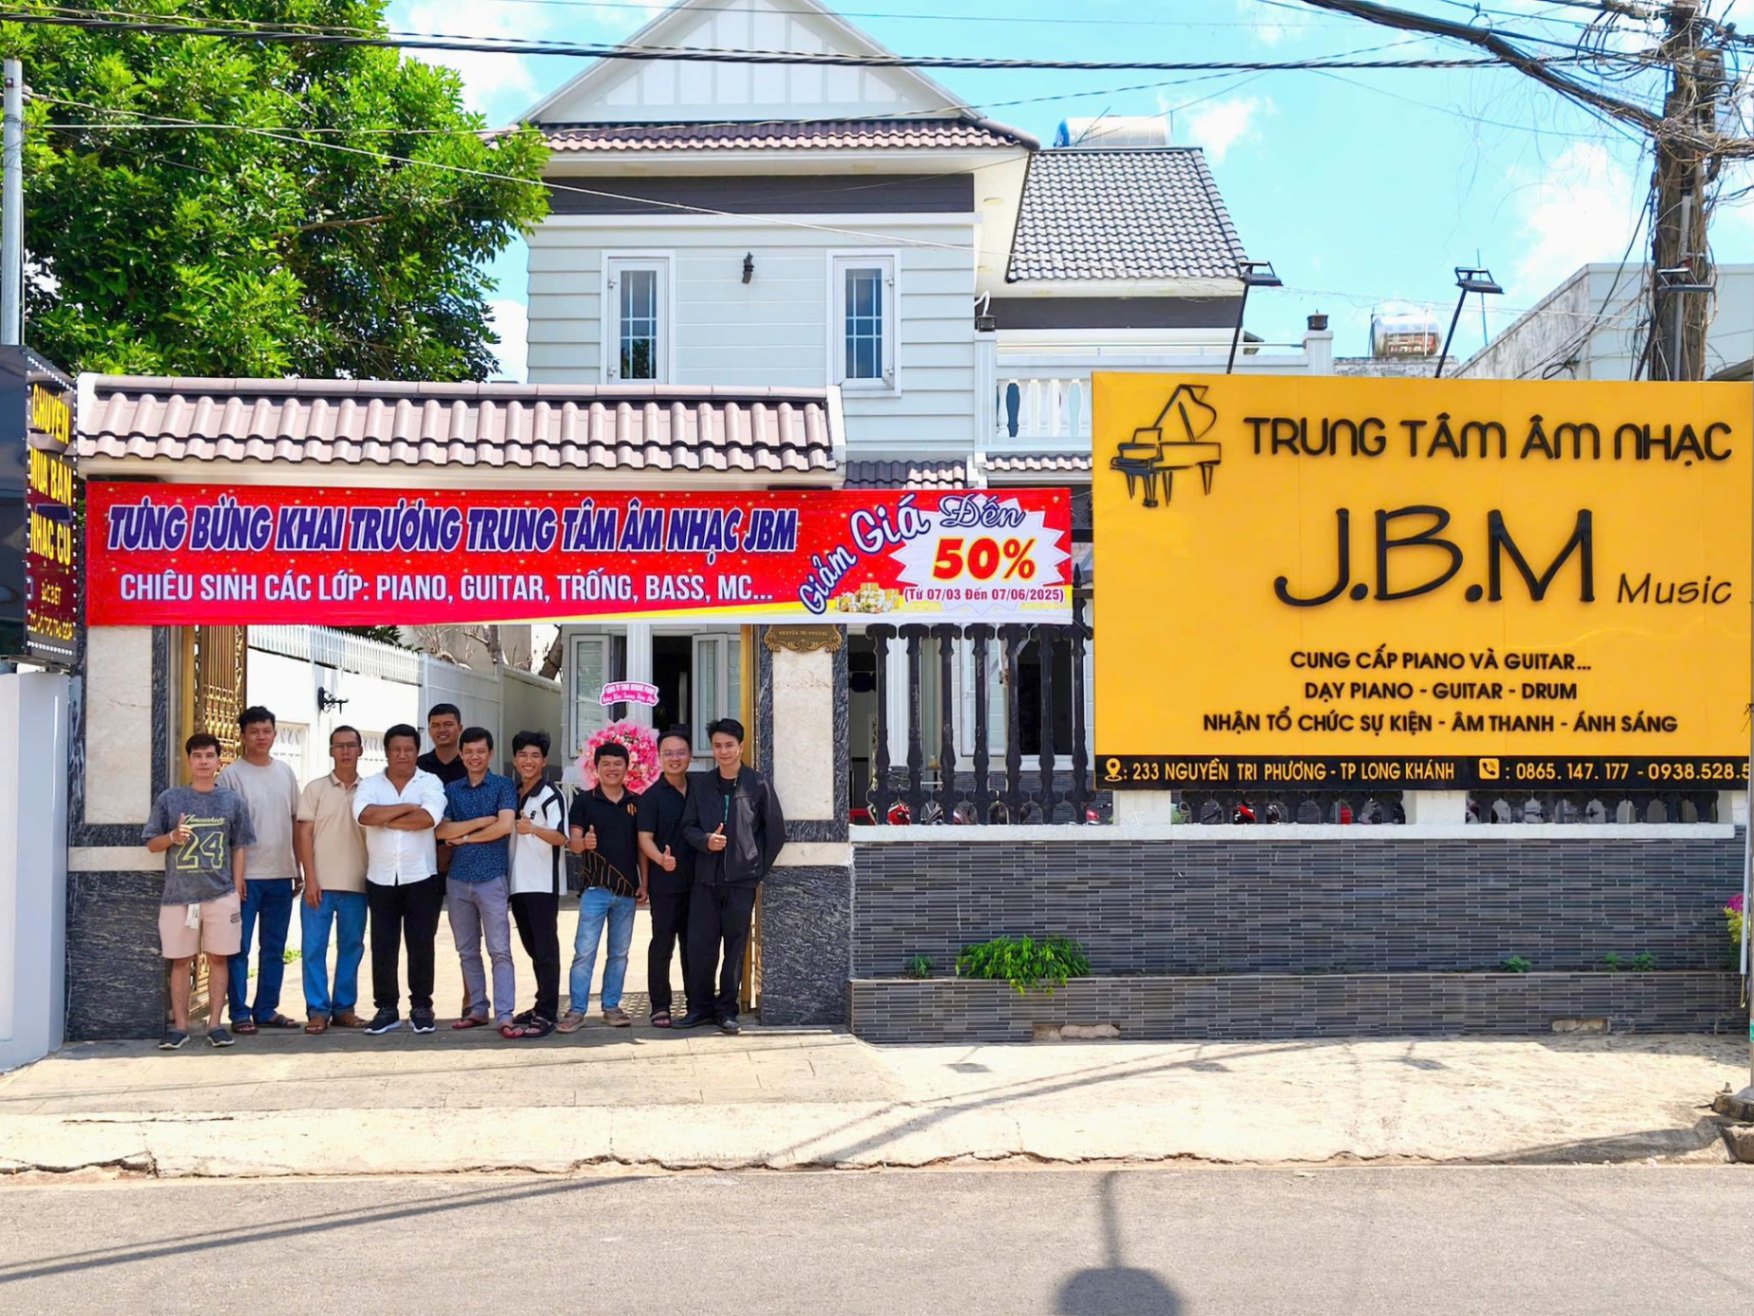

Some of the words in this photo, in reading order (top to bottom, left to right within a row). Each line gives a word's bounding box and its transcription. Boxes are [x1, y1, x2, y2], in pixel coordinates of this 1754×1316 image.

[1243, 416, 1386, 457] TRUNG
[1400, 412, 1507, 460] TÂM
[1519, 414, 1601, 461] ÂM
[1614, 421, 1734, 467] NHẠC
[30, 445, 48, 497] MUA
[50, 454, 72, 507] BÁN
[30, 511, 54, 567] NHẠC
[56, 522, 72, 575] CỤ
[189, 493, 273, 552] BỪNG
[275, 506, 346, 552] KHAI
[349, 497, 463, 553] TRƯƠNG
[466, 506, 559, 553] TRUNG
[561, 496, 619, 553] TÂM
[617, 496, 666, 552] ÂM
[665, 507, 743, 566] NHẠC
[742, 508, 799, 553] JBM
[799, 544, 859, 615] Giảm
[849, 492, 931, 555] Giá
[938, 493, 1026, 528] Đến
[932, 536, 1036, 581] 50%
[1273, 504, 1595, 608] J.B.M
[1617, 573, 1733, 606] Music
[120, 568, 193, 601] CHIÊU
[200, 574, 257, 601] SINH
[264, 569, 311, 601] CÁC
[318, 569, 369, 601] LỚP:
[376, 574, 454, 604] PIANO,
[460, 574, 550, 604] GUITAR,
[557, 567, 638, 604] TRỐNG,
[645, 574, 711, 603] BASS,
[717, 574, 773, 601] MC...
[927, 588, 962, 601] 07/03
[965, 586, 988, 601] Đến
[991, 587, 1064, 602] 07/06/2025)
[1290, 652, 1350, 669] CUNG
[1355, 643, 1398, 669] CẤP
[1402, 653, 1465, 670] PIANO
[1469, 648, 1499, 670] VÀ
[1504, 653, 1592, 671] GUITAR...
[1305, 682, 1345, 703] DẠY
[1350, 682, 1414, 700] PIANO
[1432, 682, 1503, 700] GUITAR
[1521, 683, 1577, 700] DRUM
[1203, 710, 1260, 735] NHẬN
[1267, 706, 1292, 732] TỔ
[1297, 709, 1354, 732] CHỨC
[1360, 713, 1384, 736] SỰ
[1390, 711, 1432, 736] KIỆN
[1451, 711, 1485, 732] ÂM
[1489, 715, 1554, 732] THANH
[1573, 710, 1616, 732] ÁNH
[1621, 710, 1678, 733] SÁNG
[1132, 762, 1160, 780] 233
[1237, 762, 1258, 780] TRI
[1264, 759, 1327, 780] PHƯƠNG
[1341, 762, 1356, 780] TP
[1361, 762, 1401, 780] LONG
[1405, 759, 1455, 780] KHÁNH
[1516, 762, 1562, 780] 0865.
[1567, 762, 1600, 780] 147.
[1605, 762, 1630, 780] 177
[176, 831, 225, 870] 24
